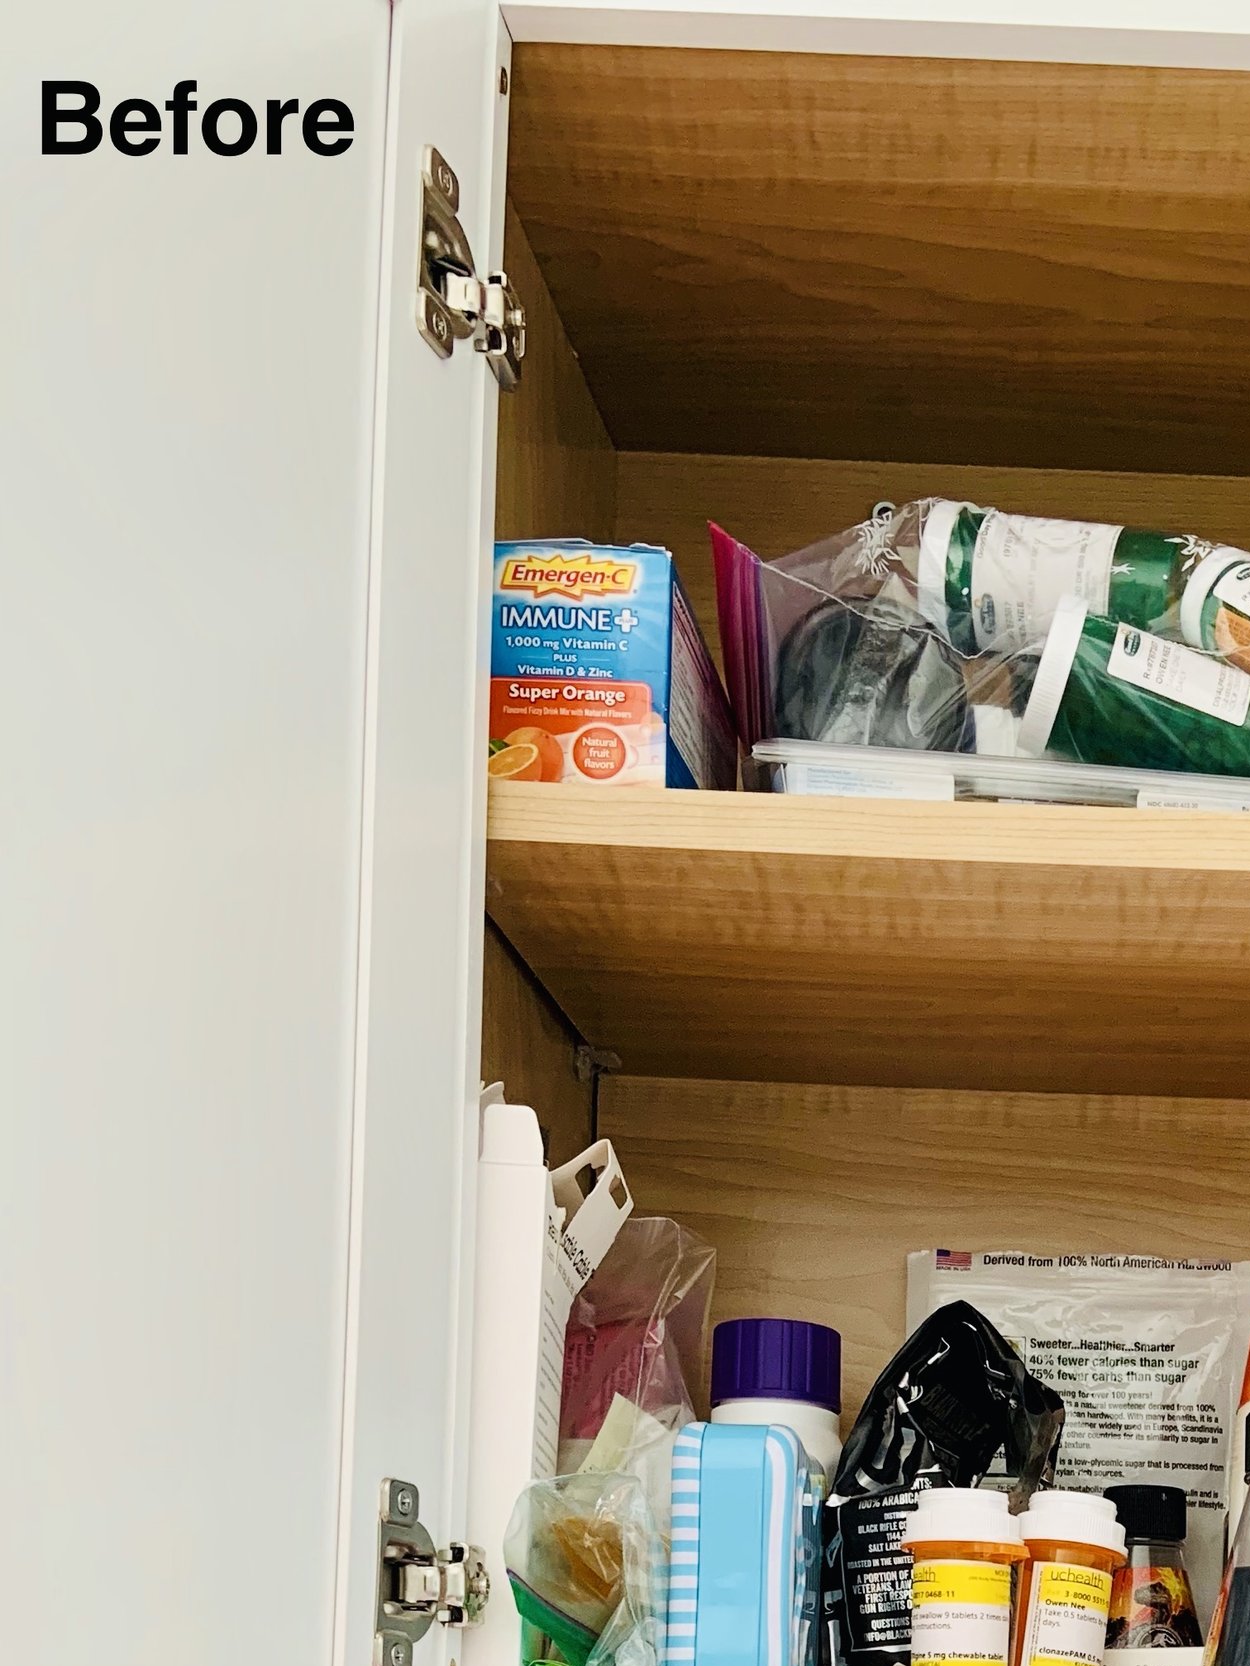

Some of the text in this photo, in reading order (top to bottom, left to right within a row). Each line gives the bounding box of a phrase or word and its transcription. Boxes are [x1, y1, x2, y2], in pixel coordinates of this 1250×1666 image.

[511, 564, 627, 587] Emergen-C
[505, 636, 628, 651] 1,000 mg Vitamin C
[553, 653, 577, 663] PLUS
[509, 684, 625, 706] Super Orange
[582, 737, 617, 748] Natural
[589, 749, 610, 759] fruit
[584, 759, 614, 770] flavors
[983, 1255, 1025, 1266] Derived
[1028, 1256, 1053, 1267] from
[1091, 1256, 1119, 1268] North
[1123, 1257, 1174, 1269] American
[1030, 1355, 1199, 1371] 40% fewer calories than sugar
[858, 1522, 897, 1534] BLACK RIFLE
[1050, 1568, 1104, 1589] uchealth
[860, 1602, 905, 1615] GUN RIGHTS
